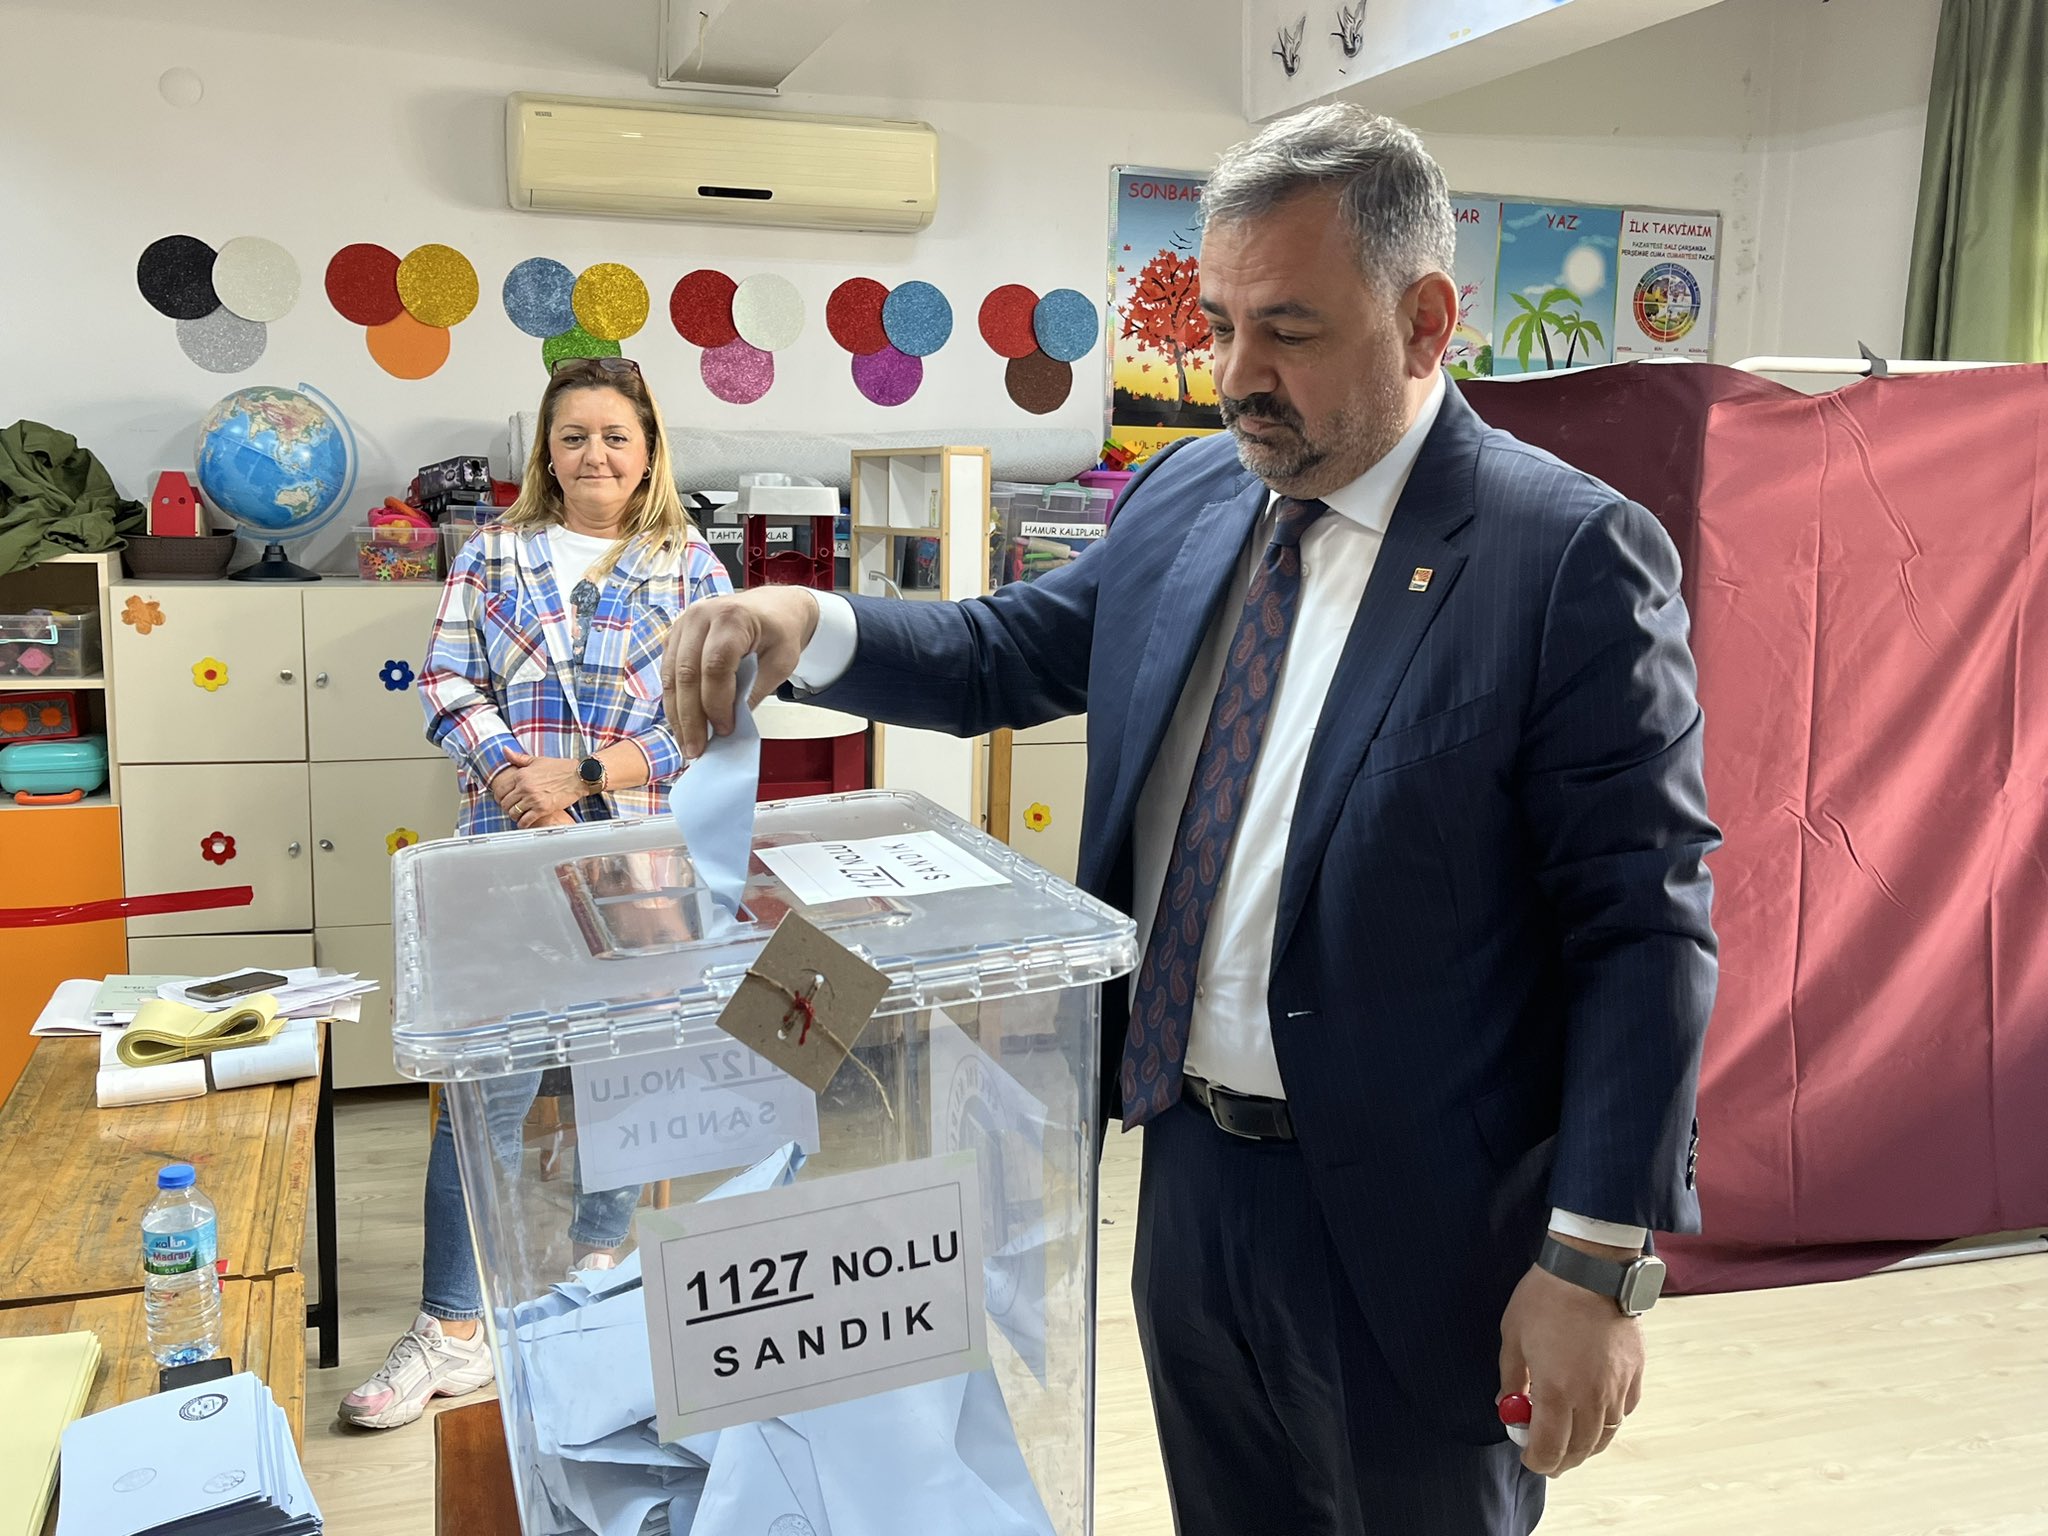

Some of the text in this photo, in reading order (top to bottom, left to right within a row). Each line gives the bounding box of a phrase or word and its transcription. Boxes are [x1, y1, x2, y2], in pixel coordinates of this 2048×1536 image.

[1546, 213, 1579, 231] YAZ
[1628, 219, 1649, 234] İLK
[1024, 525, 1105, 537] HAMUR KALIPLARI
[880, 843, 951, 882] SANDIK
[838, 866, 894, 890] 1127
[153, 1250, 191, 1262] Madran
[686, 1230, 959, 1325] 1127 NO.LU
[713, 1300, 935, 1378] SANDIK
